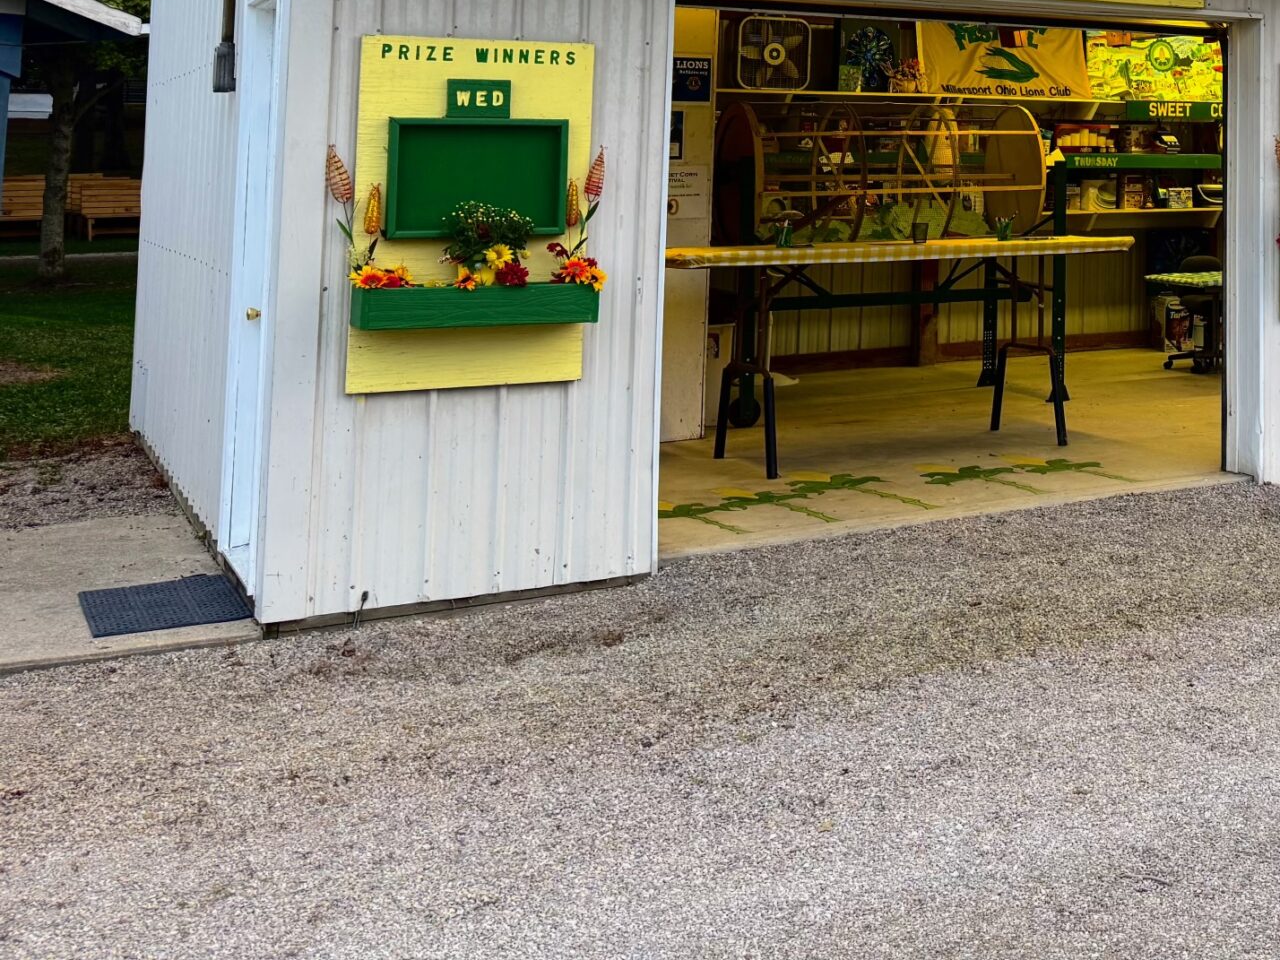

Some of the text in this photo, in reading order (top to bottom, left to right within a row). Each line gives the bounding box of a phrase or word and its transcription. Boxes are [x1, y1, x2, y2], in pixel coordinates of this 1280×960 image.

[381, 43, 577, 65] PRIZE WINNERS
[676, 60, 709, 69] LIONS
[995, 85, 1017, 96] Ohio
[1020, 85, 1045, 97] Lions
[1049, 86, 1072, 97] Club
[456, 90, 504, 107] WED
[1149, 102, 1192, 117] SWEET
[1073, 156, 1118, 167] THURSDAY
